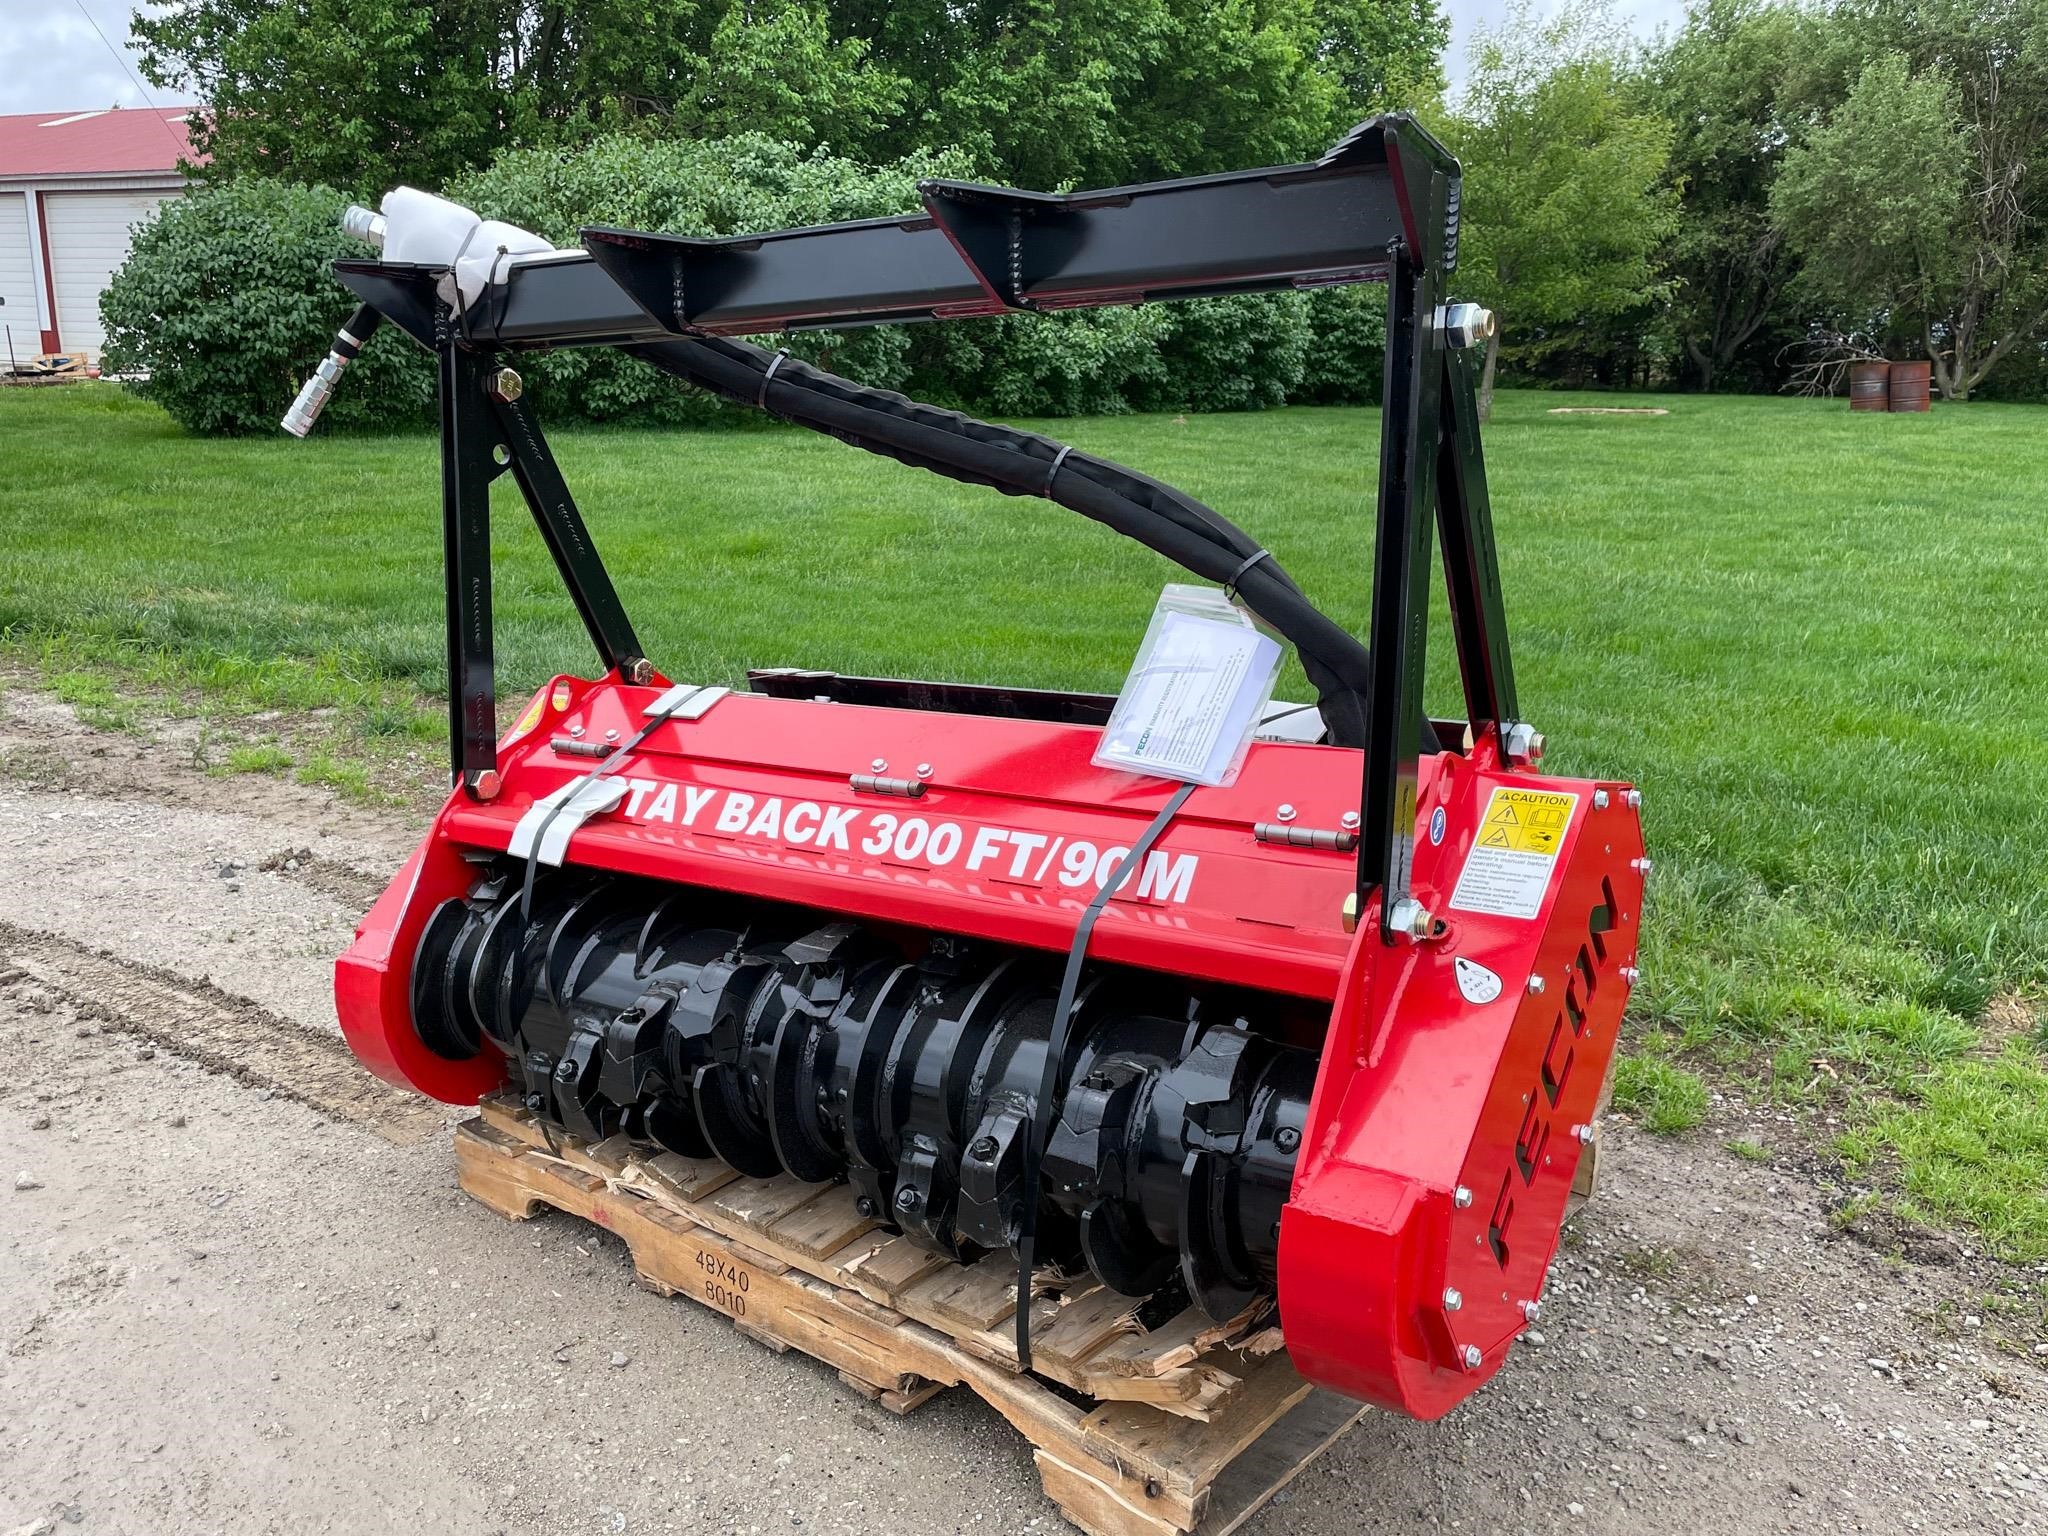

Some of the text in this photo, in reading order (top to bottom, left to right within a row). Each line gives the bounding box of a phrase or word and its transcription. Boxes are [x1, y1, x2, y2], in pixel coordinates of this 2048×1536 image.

[1135, 727, 1153, 756] FECON
[1511, 792, 1569, 806] CAUTION
[715, 791, 862, 851] BACK
[861, 813, 962, 866] 300
[1488, 873, 1618, 1274] FECON
[695, 1249, 749, 1293] 48X40
[705, 1280, 746, 1317] 8010
